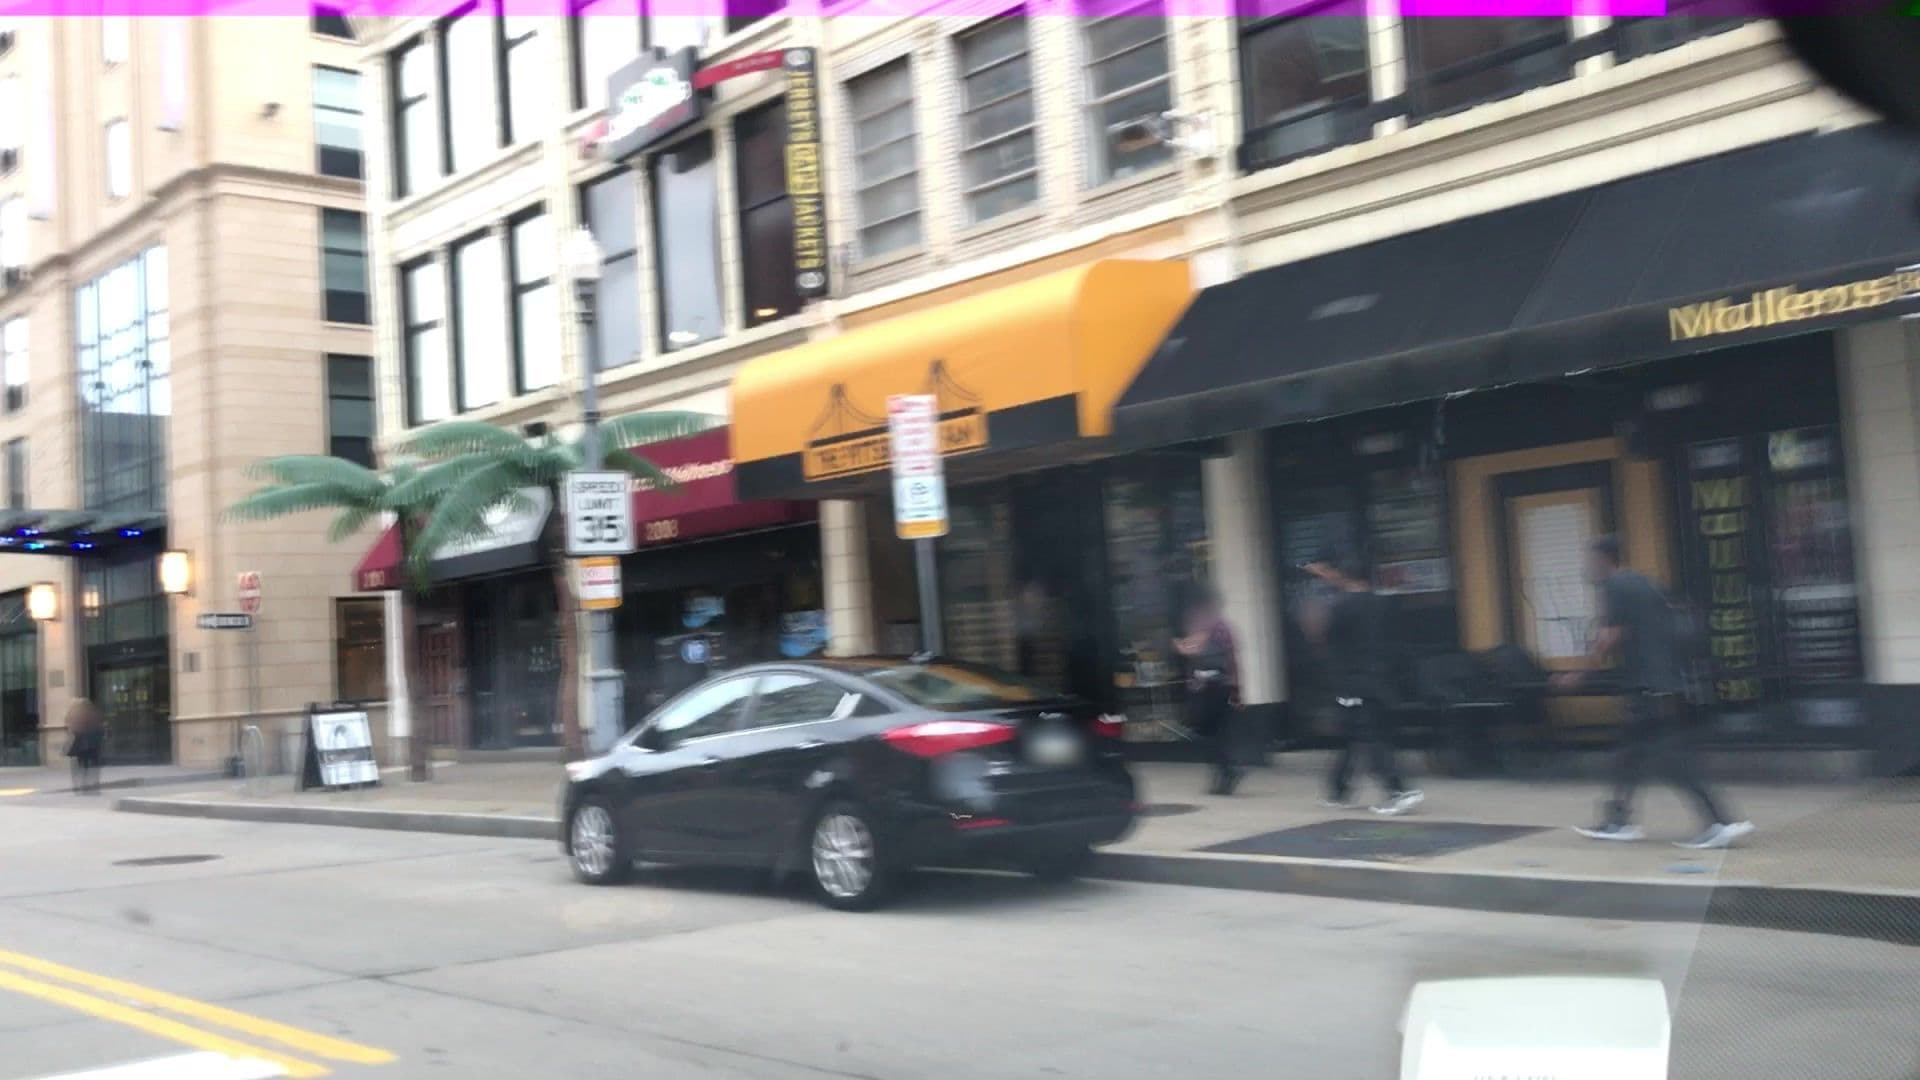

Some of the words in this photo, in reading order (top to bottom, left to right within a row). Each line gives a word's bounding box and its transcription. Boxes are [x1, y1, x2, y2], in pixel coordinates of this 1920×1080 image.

[573, 481, 621, 493] SPEED
[578, 498, 618, 510] LIMIT
[577, 515, 625, 544] 35
